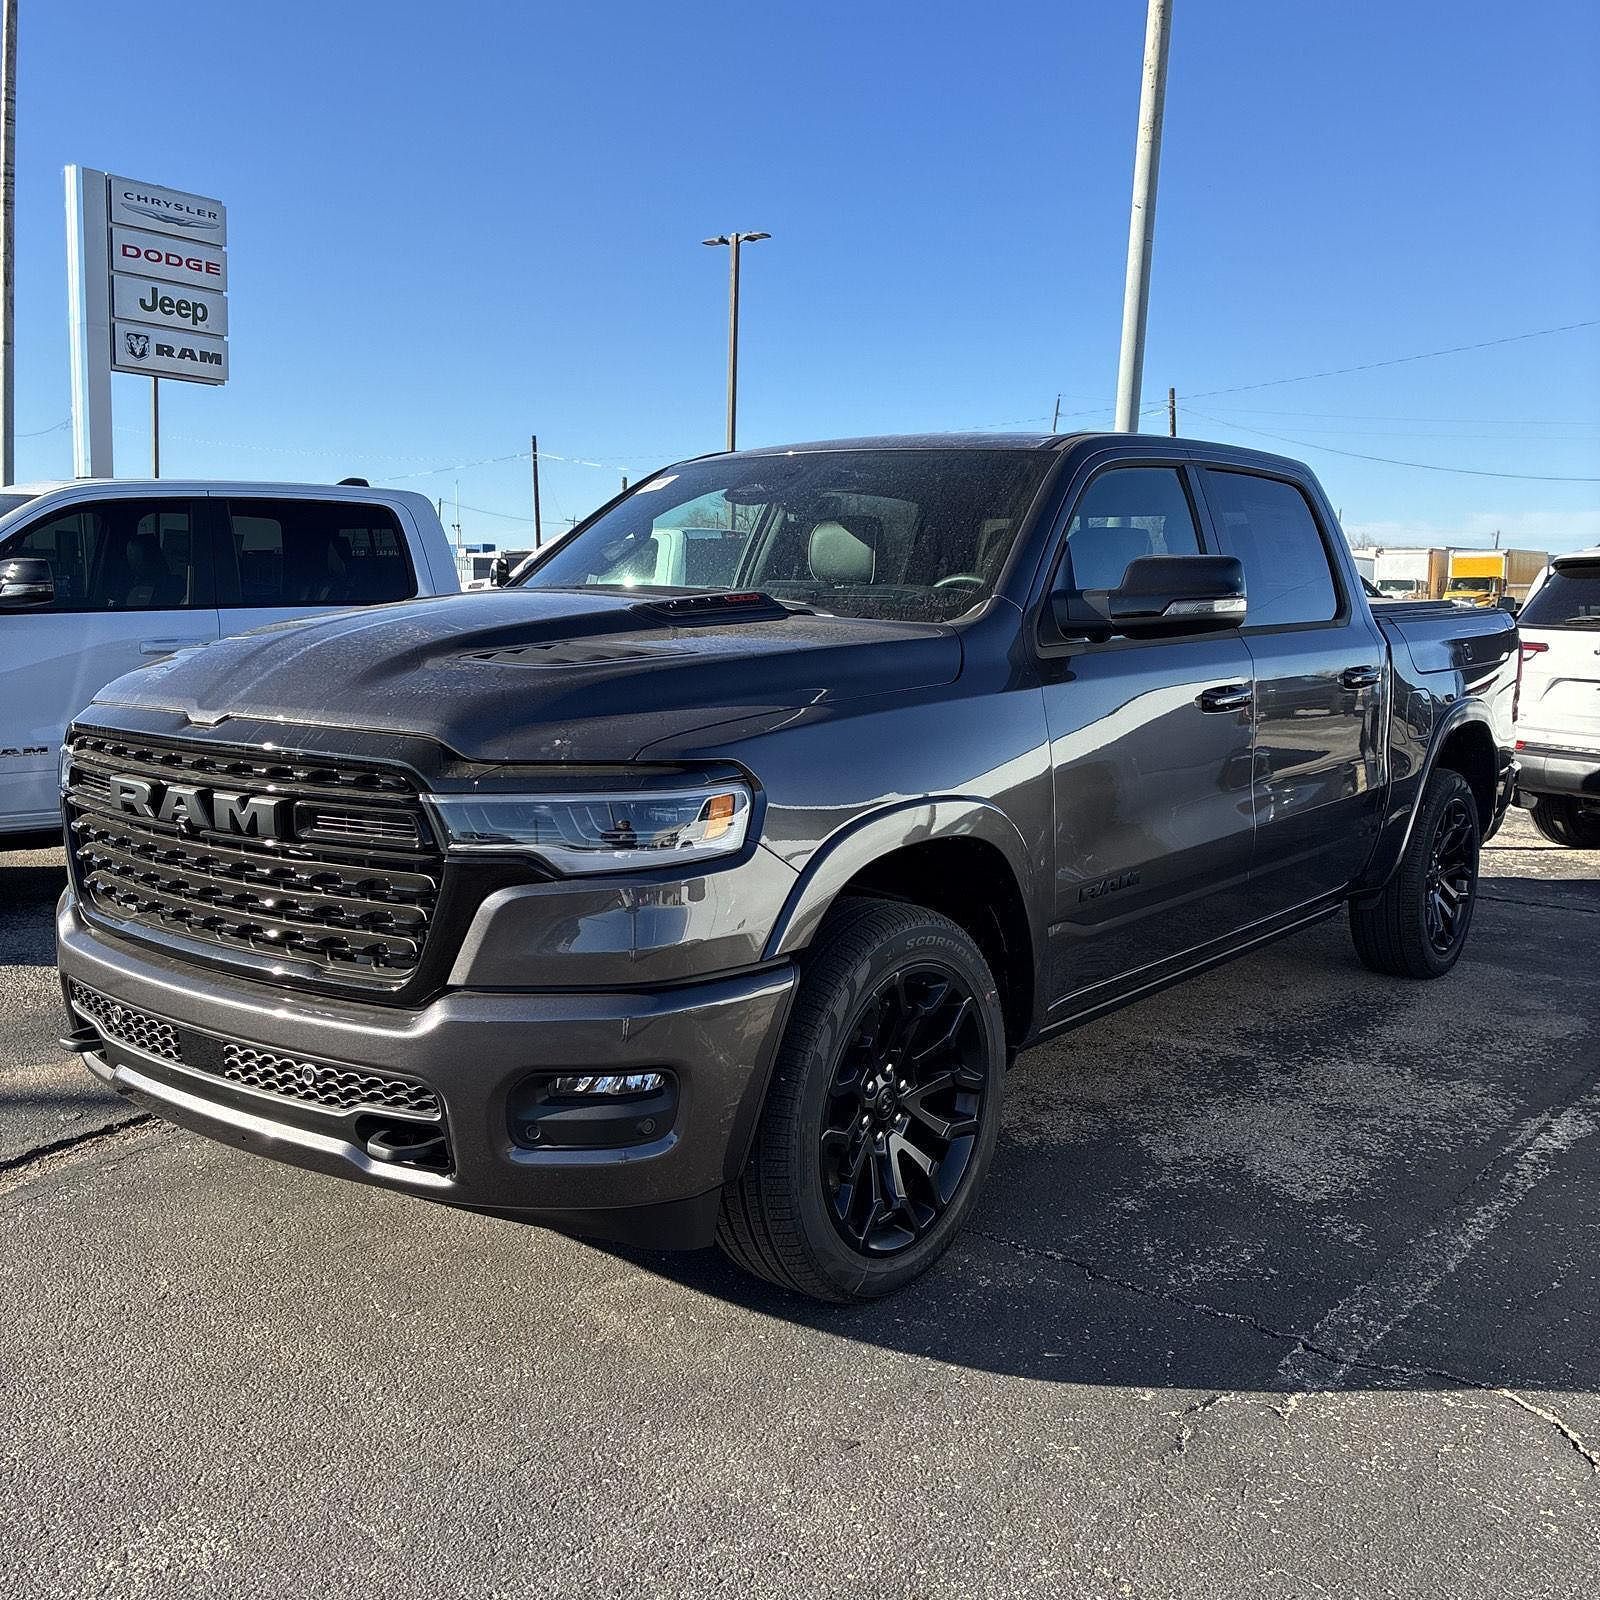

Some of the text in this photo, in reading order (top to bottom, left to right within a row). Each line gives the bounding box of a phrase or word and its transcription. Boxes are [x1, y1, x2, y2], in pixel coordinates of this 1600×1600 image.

[123, 191, 218, 220] CHRYSLER
[121, 243, 221, 276] DODGE
[139, 286, 208, 326] Jeep
[155, 343, 222, 366] RAM
[0, 746, 49, 758] AM
[110, 773, 284, 839] RAM
[905, 935, 975, 964] SCORPION
